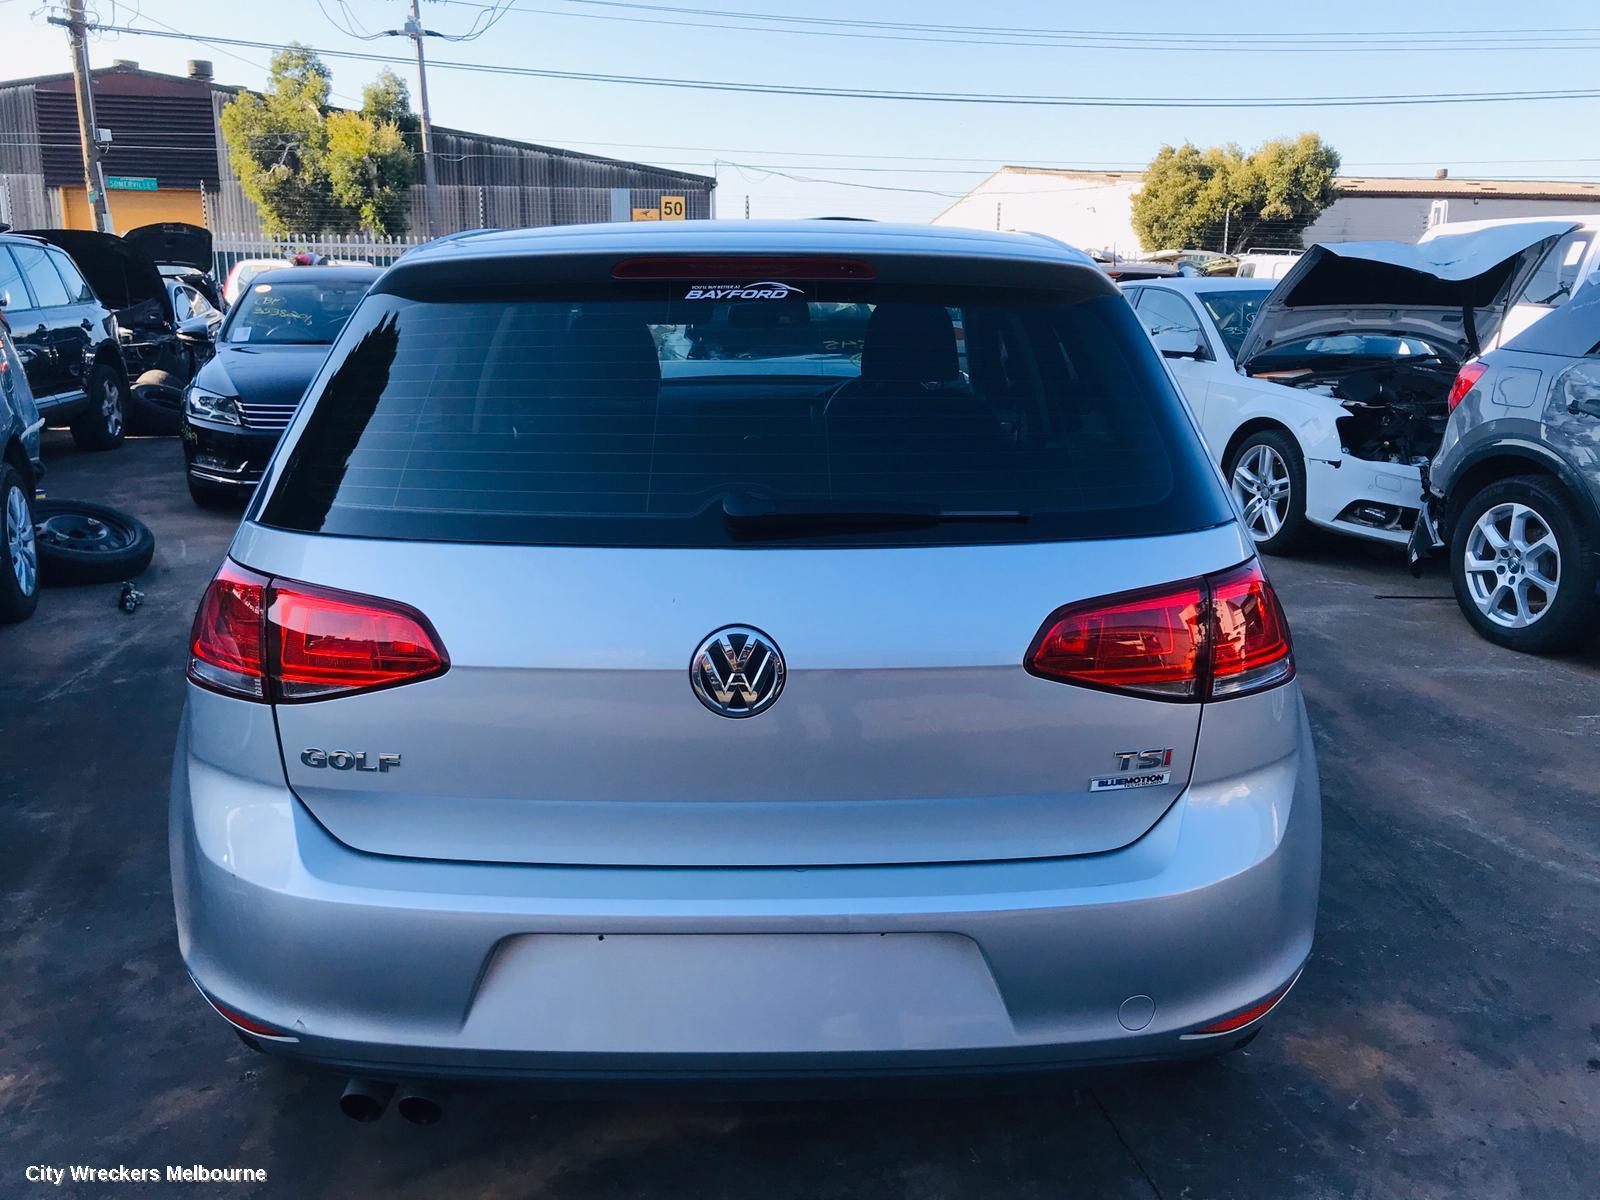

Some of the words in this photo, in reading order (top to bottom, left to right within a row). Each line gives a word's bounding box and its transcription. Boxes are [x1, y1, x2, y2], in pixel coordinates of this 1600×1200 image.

[109, 180, 151, 189] SOMERVILLE
[664, 201, 683, 216] 50
[685, 289, 789, 300] BAYFORD
[300, 747, 402, 773] GOLF
[1114, 747, 1174, 771] TSI
[1098, 774, 1164, 787] BLUEMOTION
